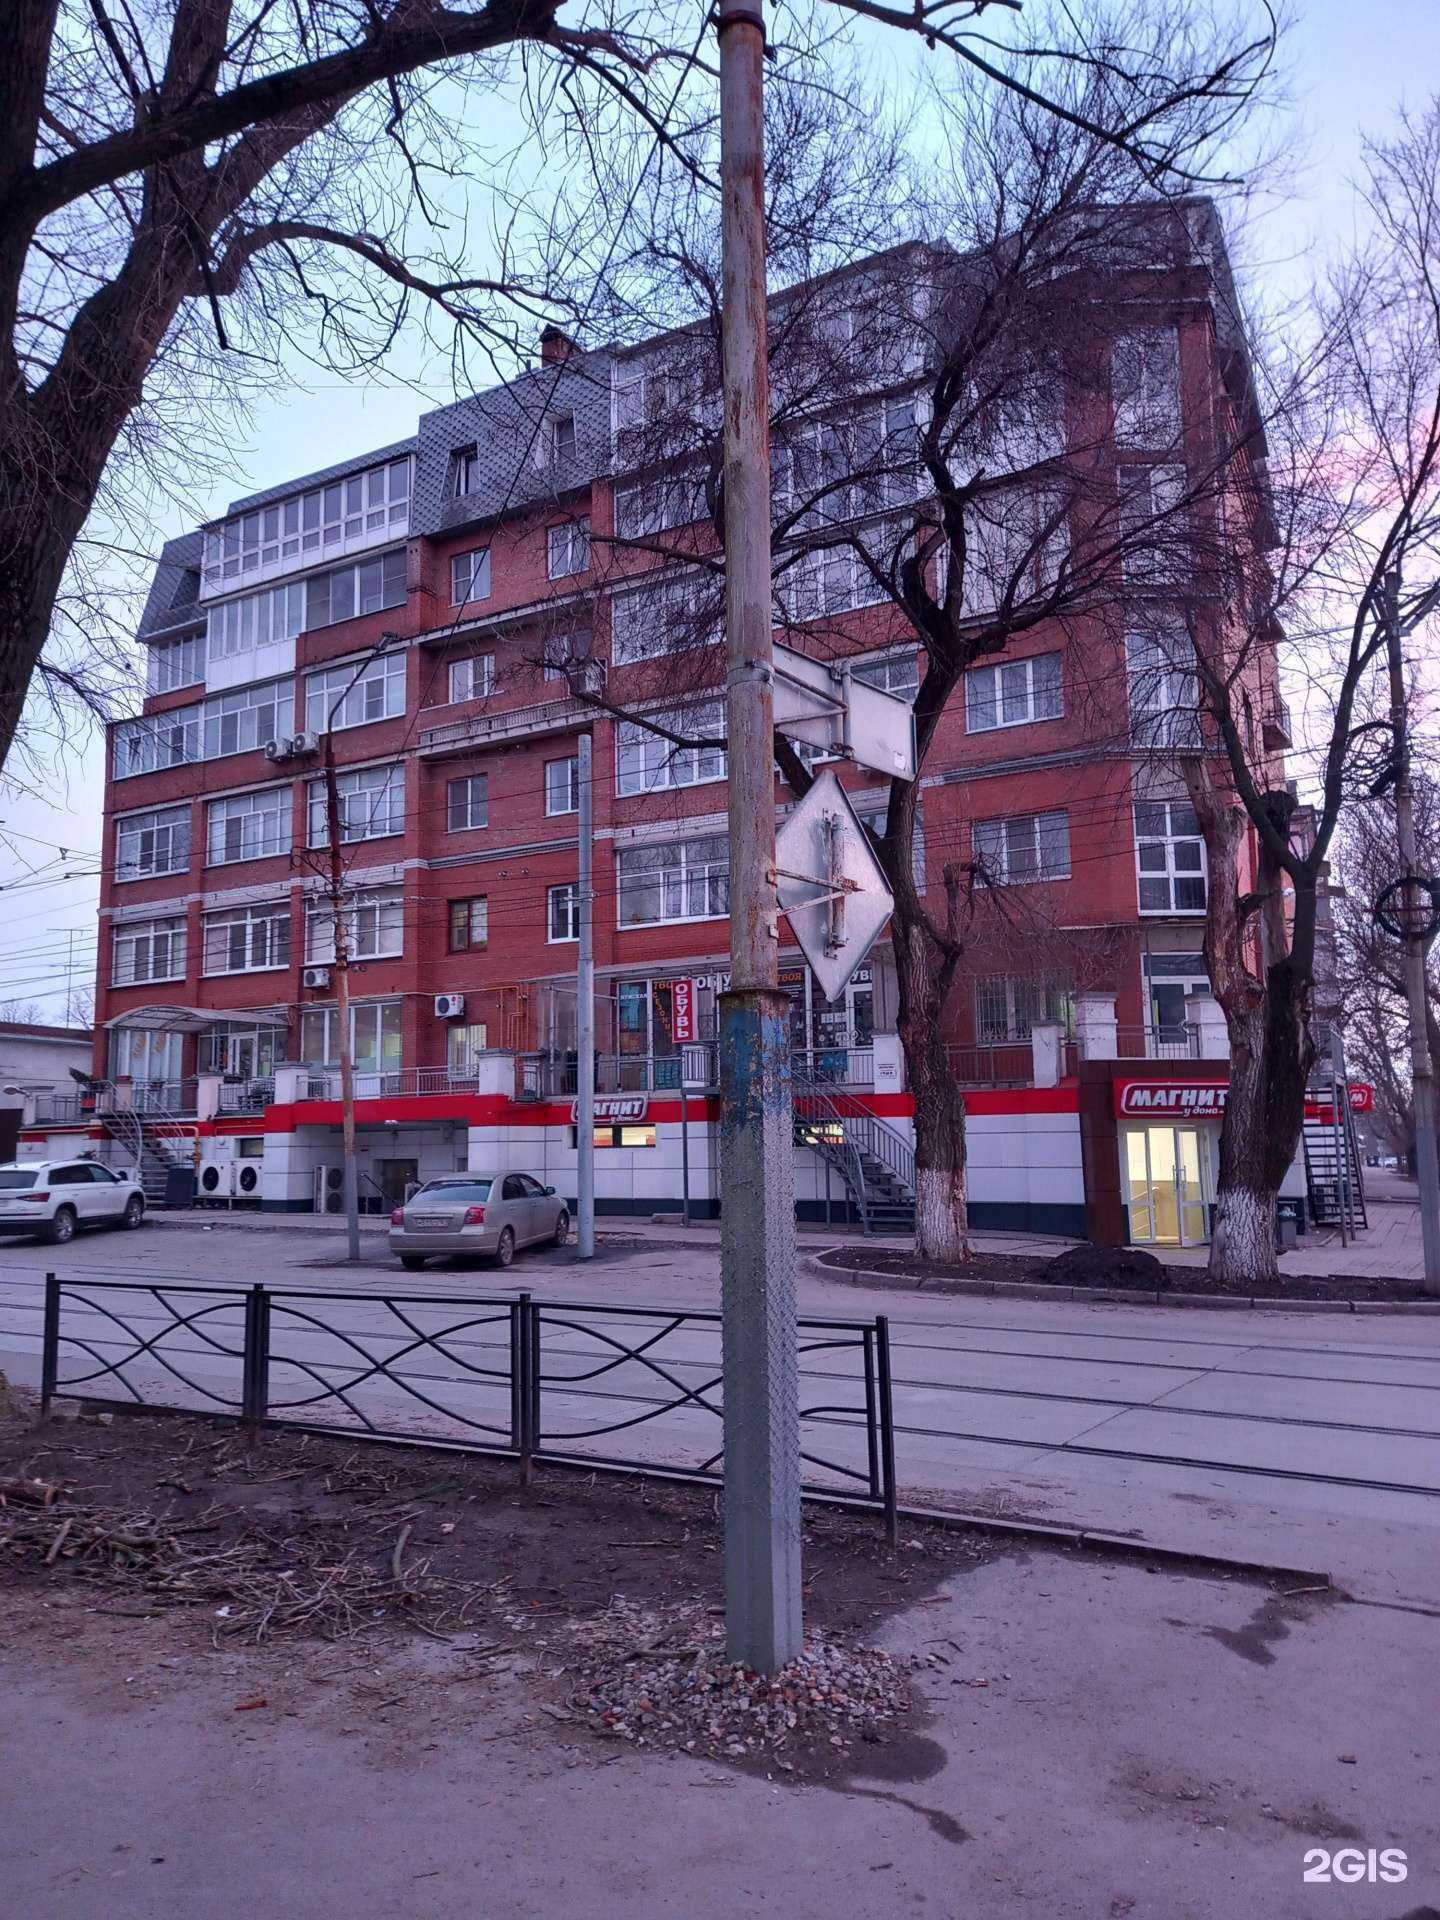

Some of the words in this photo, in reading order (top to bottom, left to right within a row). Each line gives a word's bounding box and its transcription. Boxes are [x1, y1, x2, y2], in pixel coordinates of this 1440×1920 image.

[675, 984, 689, 1038] ОБУВЬ
[1129, 1090, 1229, 1106] МАГНИТ
[576, 1101, 642, 1115] АГНИТ
